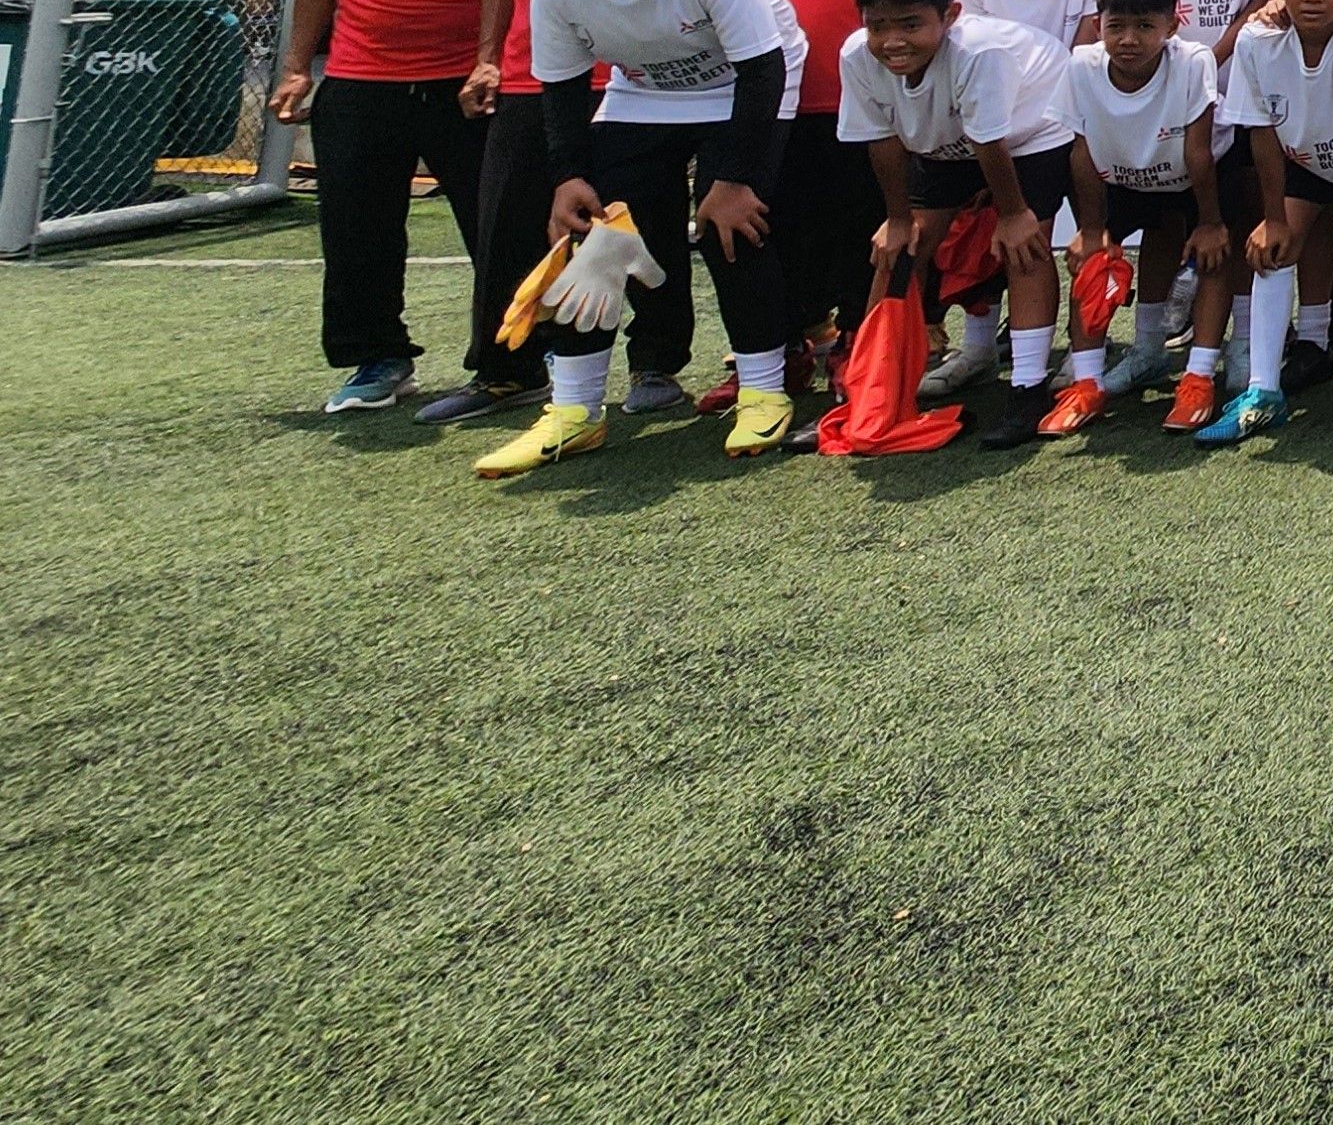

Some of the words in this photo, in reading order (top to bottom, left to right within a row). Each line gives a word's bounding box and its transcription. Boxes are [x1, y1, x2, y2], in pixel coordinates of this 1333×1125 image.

[1198, 5, 1214, 16] WE
[84, 50, 162, 76] GBK
[641, 50, 712, 72] TOGETHER
[650, 71, 671, 81] WE
[671, 65, 701, 79] CAN
[1112, 162, 1172, 176] TOGETHER
